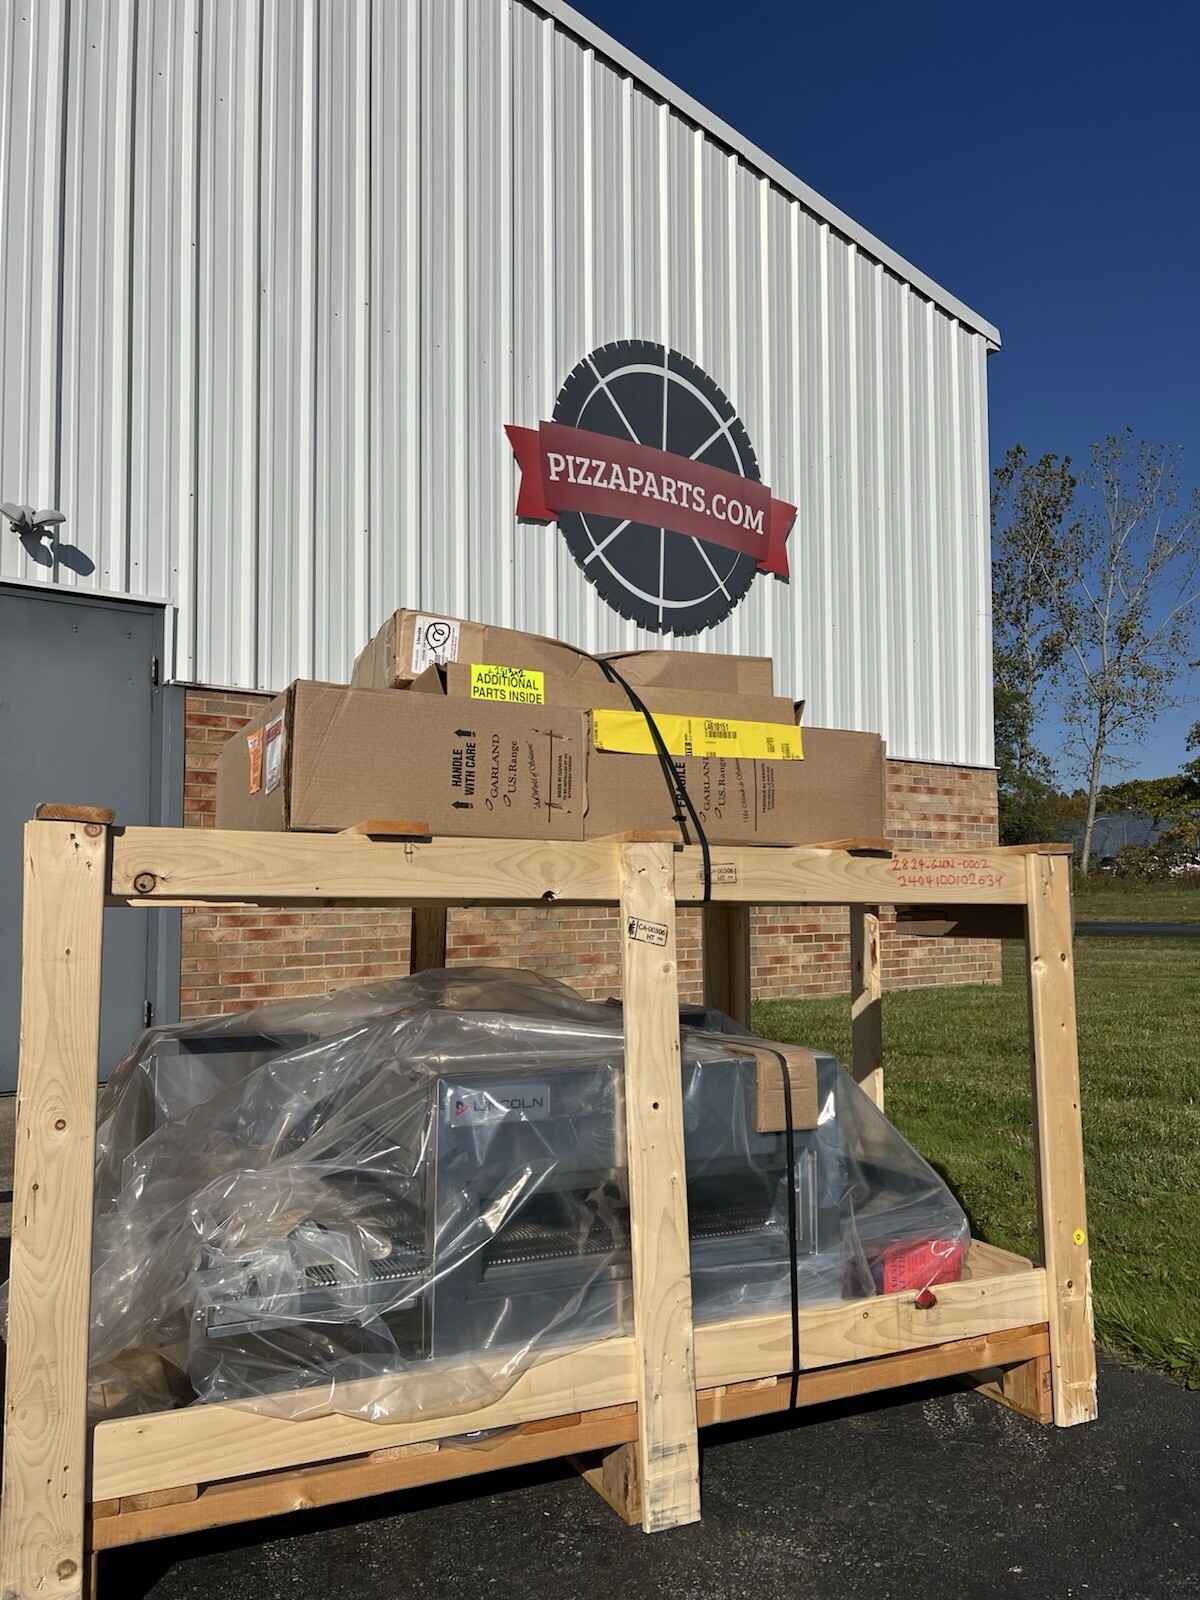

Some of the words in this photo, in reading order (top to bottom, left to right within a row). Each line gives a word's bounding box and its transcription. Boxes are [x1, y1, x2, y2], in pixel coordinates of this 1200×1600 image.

[546, 451, 765, 535] PIZZAPARTS.COM
[477, 673, 538, 690] ADDITIONAL
[473, 686, 506, 700] PARTS
[509, 690, 542, 705] INSIDE
[465, 742, 476, 768] CARE
[490, 734, 500, 798] GARLAND
[508, 740, 519, 771] Range
[452, 749, 462, 787] HANDLE
[718, 757, 727, 786] Range
[464, 771, 475, 796] WITH
[507, 774, 517, 793] U.S.
[718, 787, 726, 806] U.S.
[638, 923, 666, 936] CA-00306
[646, 933, 655, 941] HT
